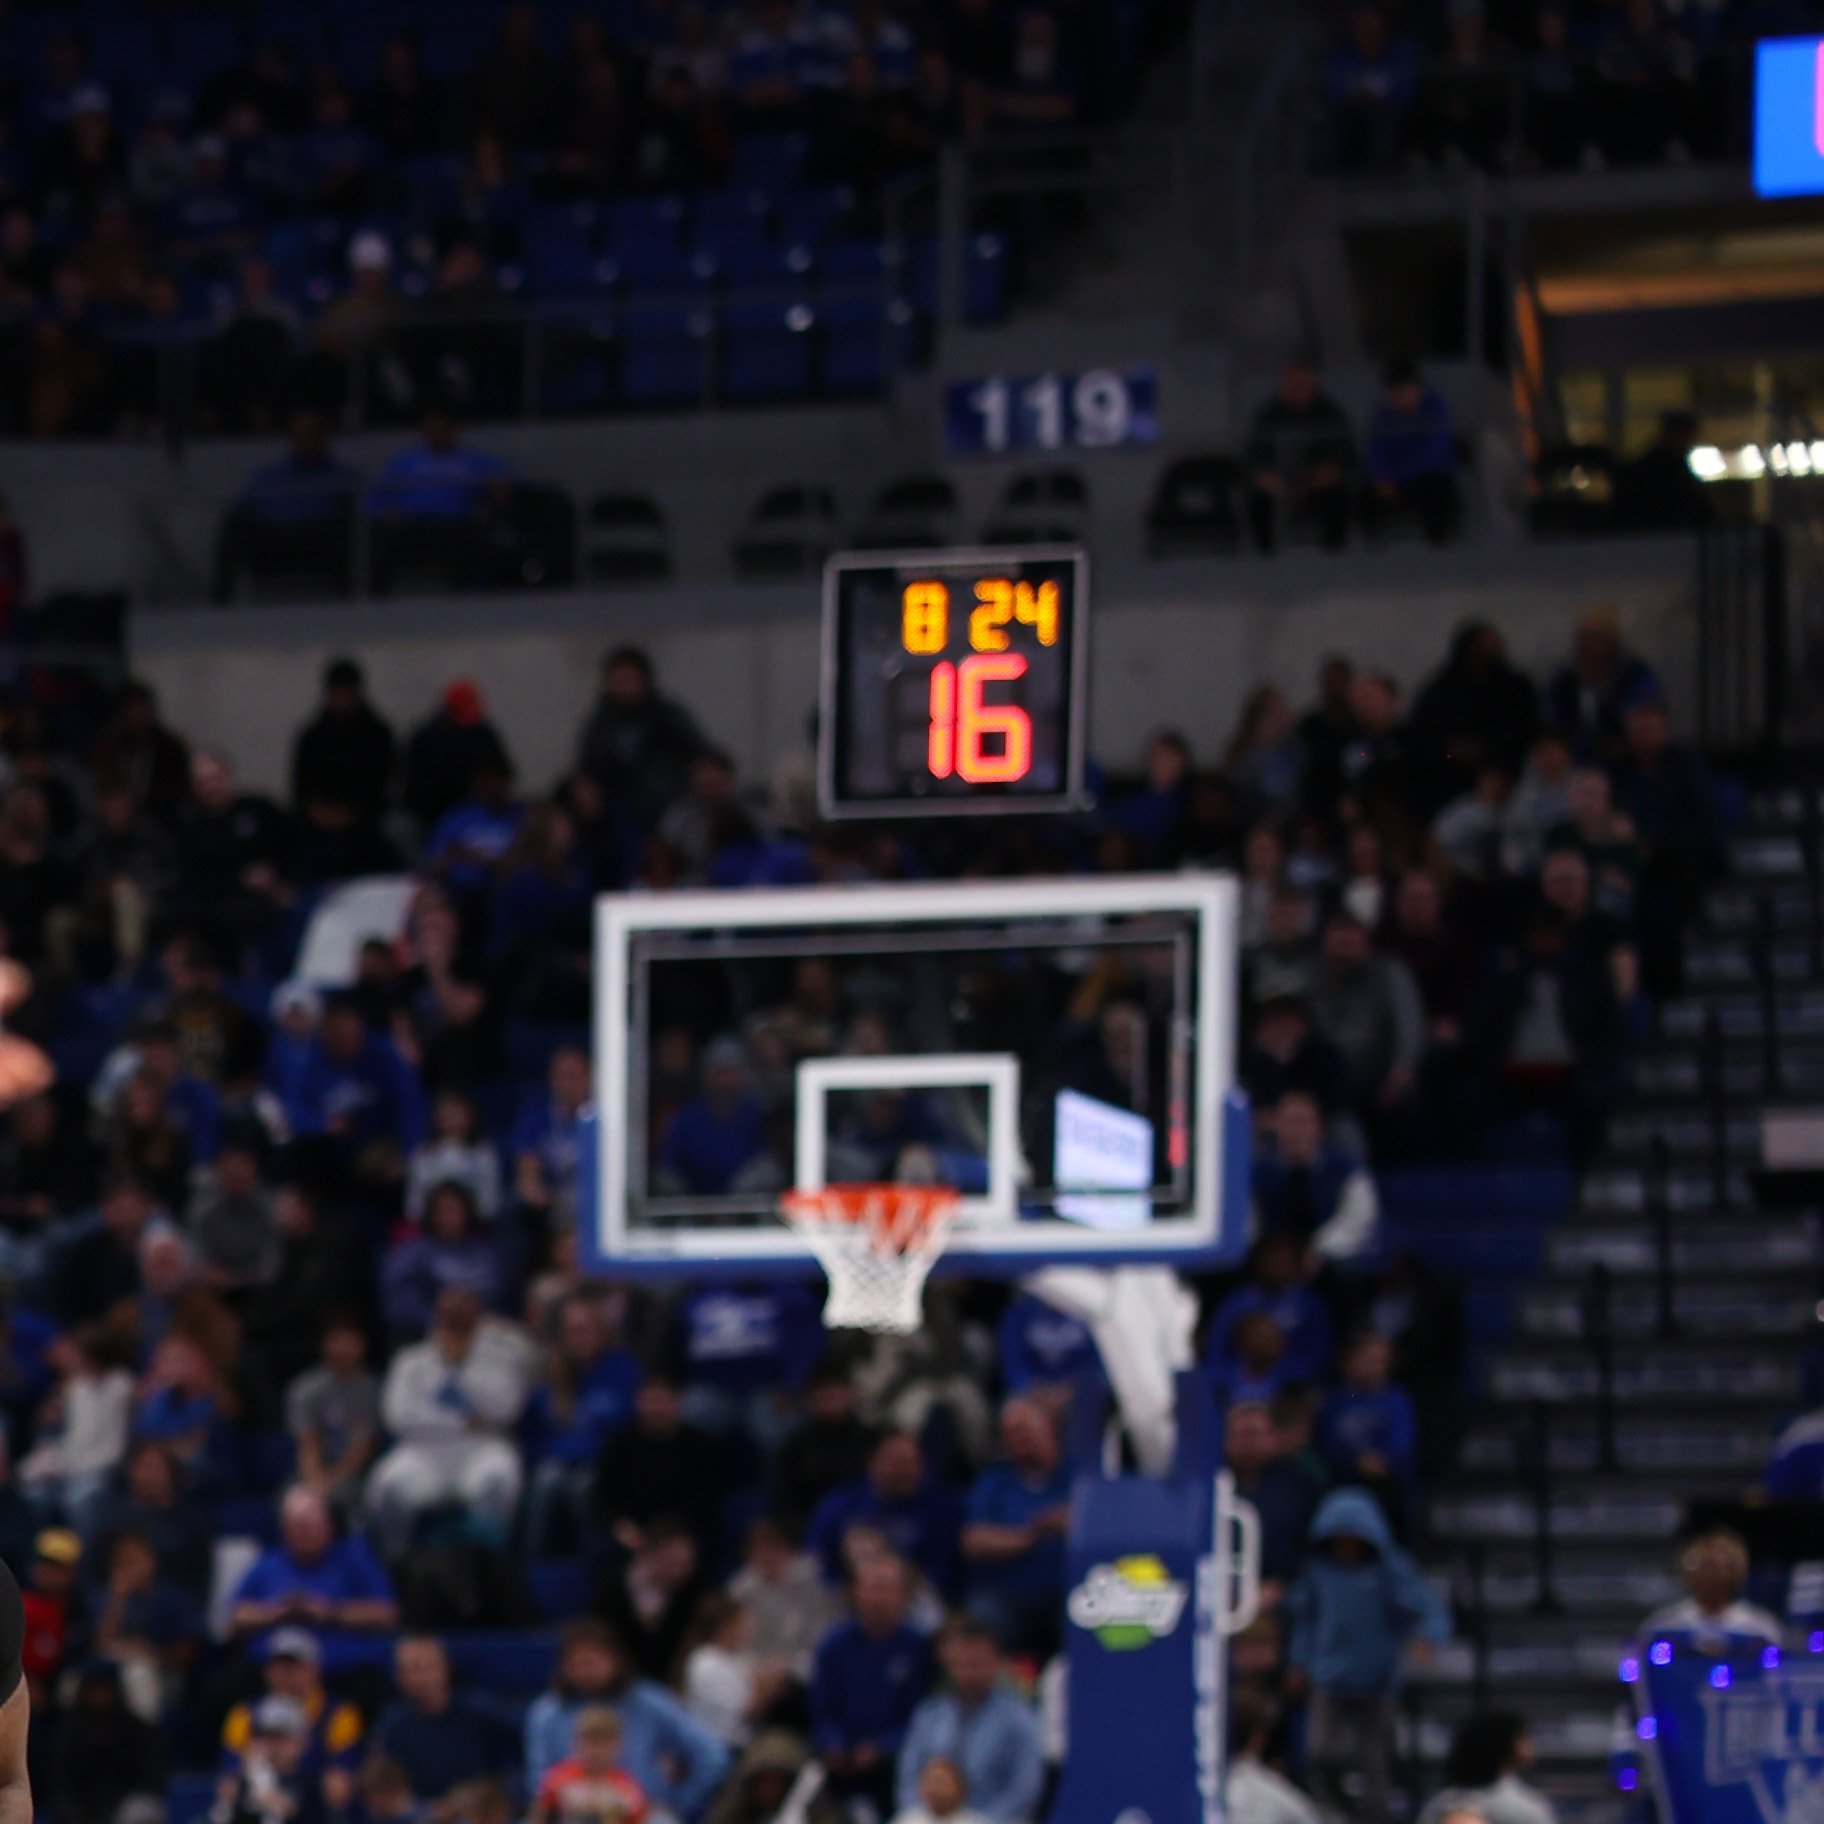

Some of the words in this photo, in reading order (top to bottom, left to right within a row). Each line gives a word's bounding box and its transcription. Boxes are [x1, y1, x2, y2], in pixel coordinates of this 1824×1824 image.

[968, 369, 1130, 450] 119
[902, 578, 950, 656] 8
[968, 576, 1060, 653] 24
[927, 652, 1033, 784] 16
